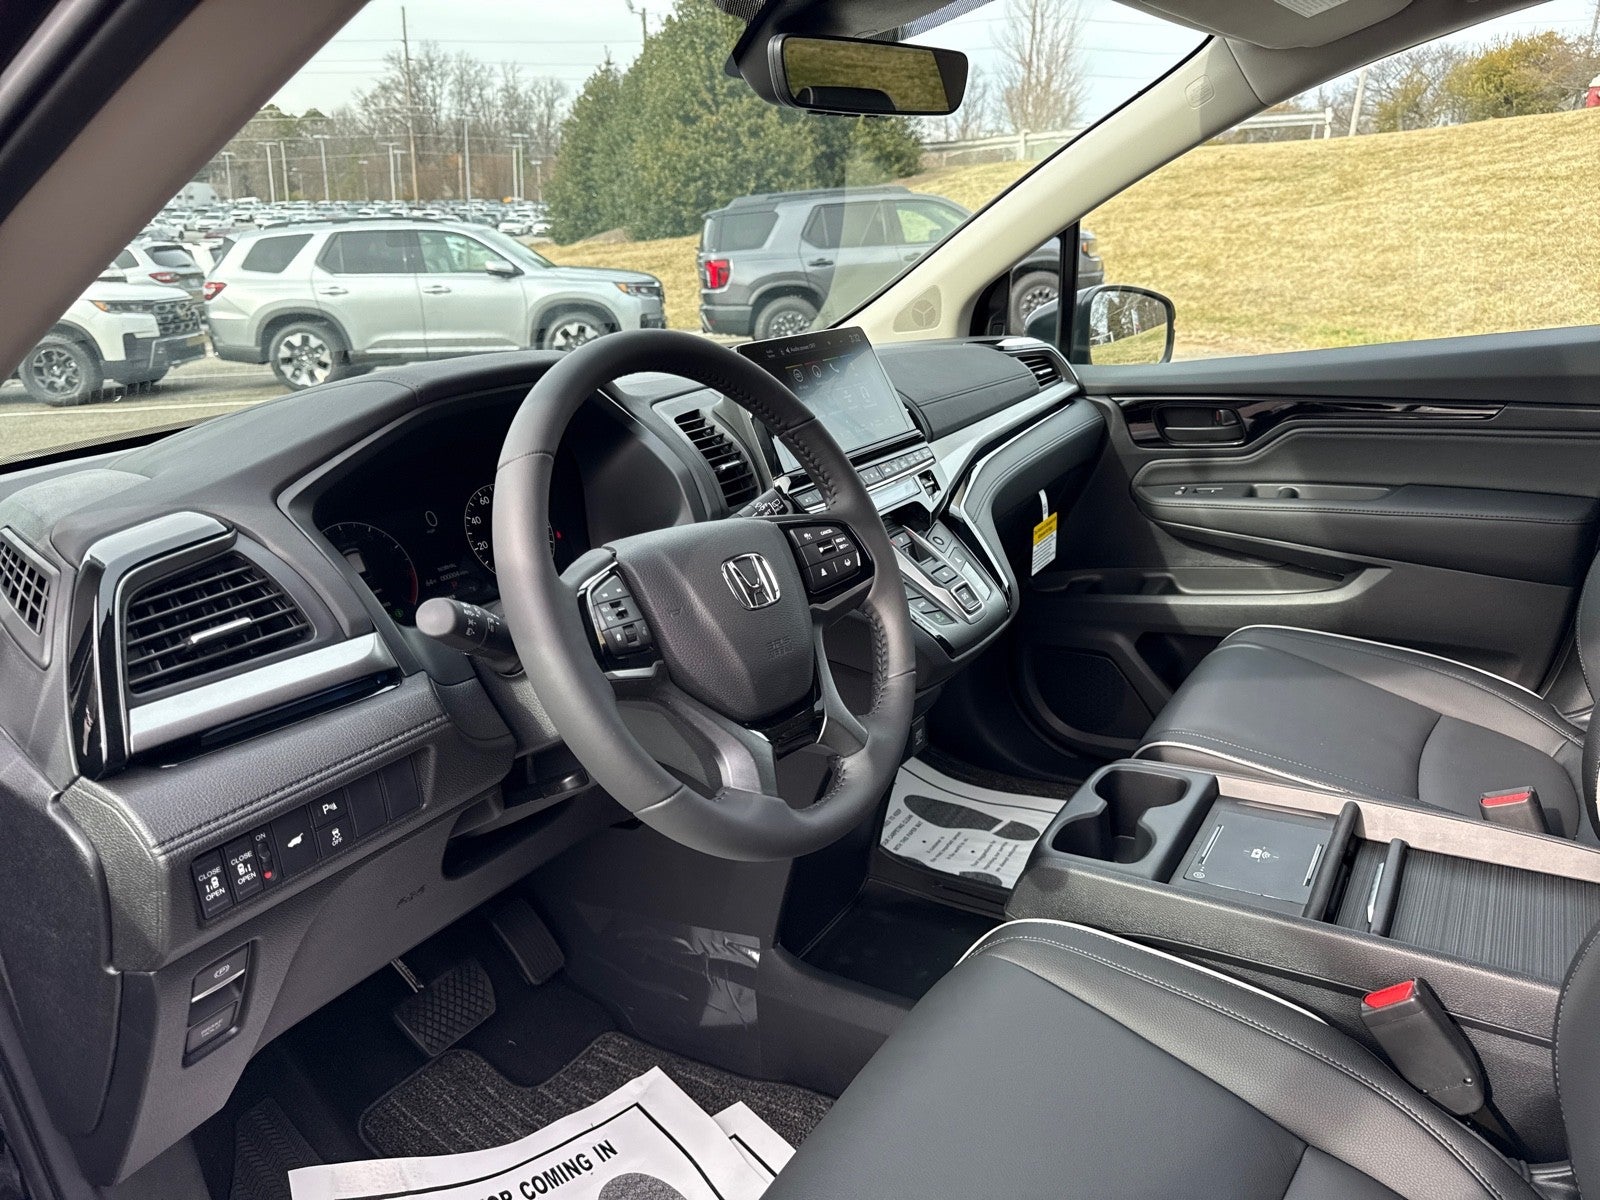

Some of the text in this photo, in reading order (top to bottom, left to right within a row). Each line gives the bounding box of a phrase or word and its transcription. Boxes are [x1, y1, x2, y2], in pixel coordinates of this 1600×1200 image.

[479, 496, 489, 505] 60
[425, 510, 438, 527] 0
[471, 515, 482, 525] 40
[477, 540, 489, 550] 20
[255, 832, 266, 841] ON
[231, 850, 253, 866] CLOSE
[198, 866, 221, 882] CLOSE
[238, 871, 256, 885] OPEN
[206, 887, 226, 901] OPEN
[519, 1139, 618, 1200] COMING IN
